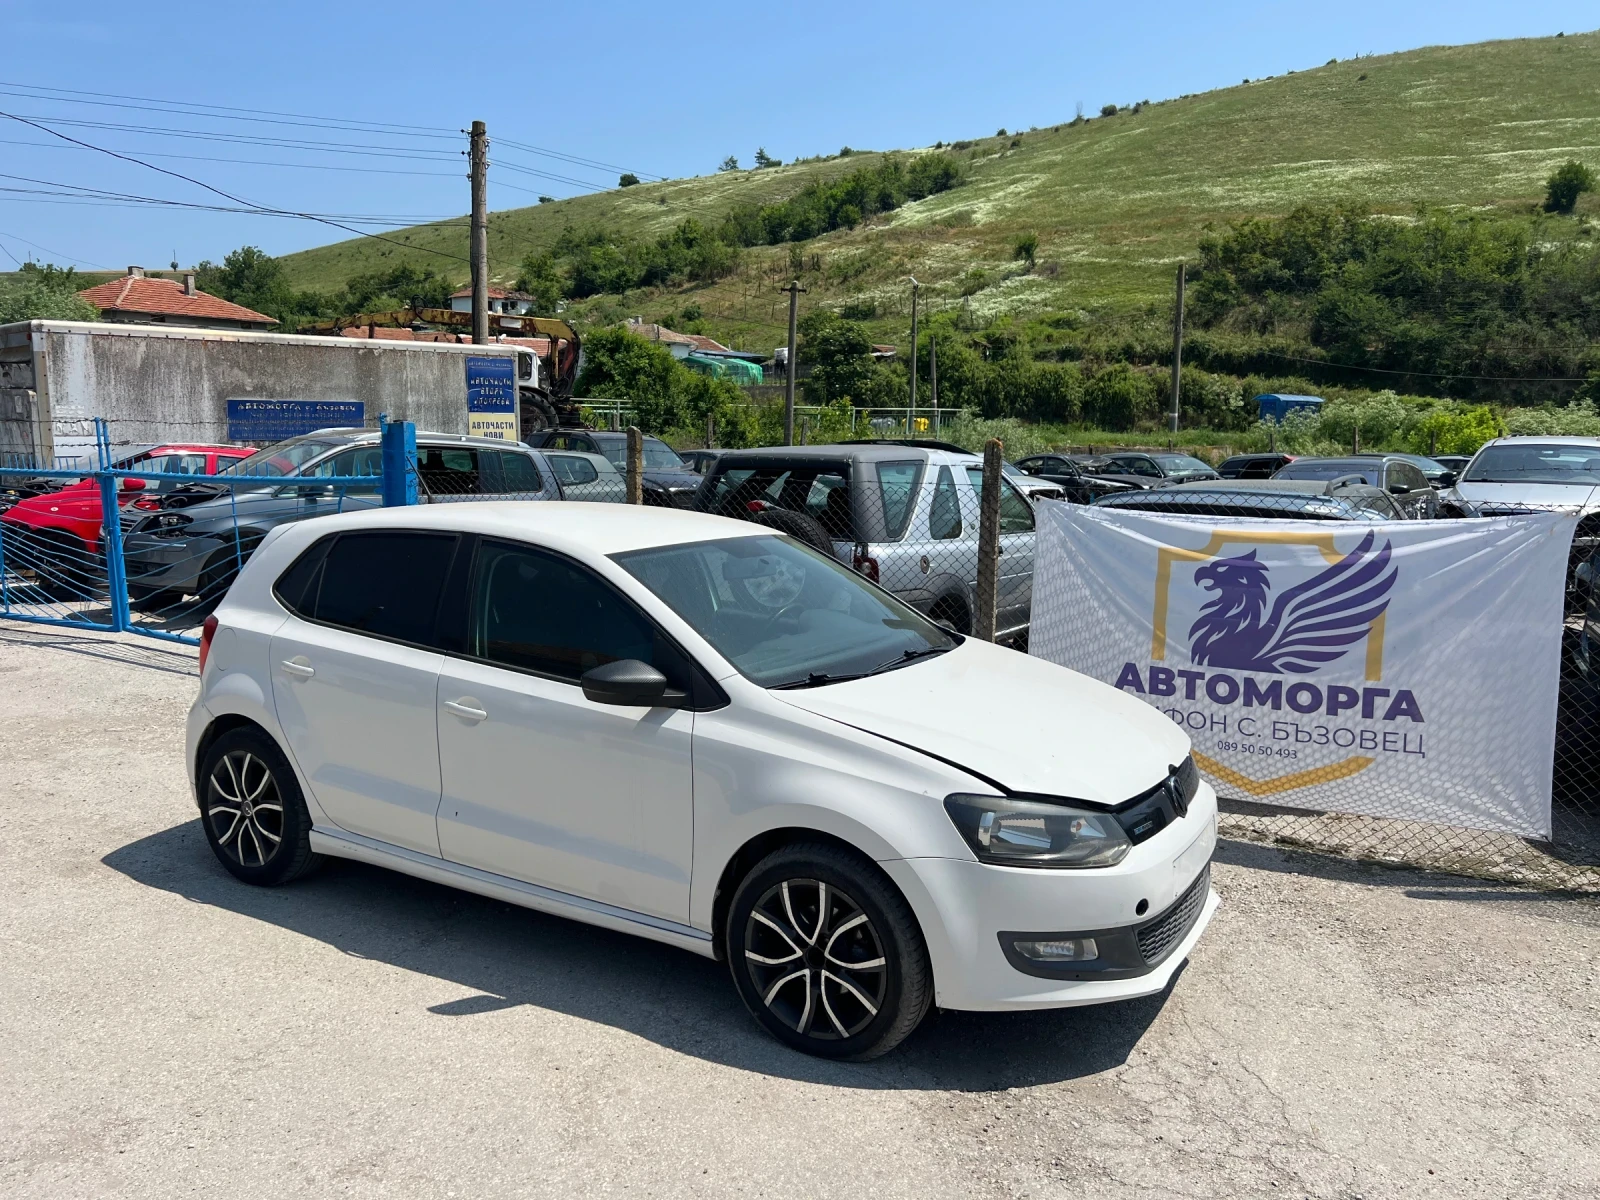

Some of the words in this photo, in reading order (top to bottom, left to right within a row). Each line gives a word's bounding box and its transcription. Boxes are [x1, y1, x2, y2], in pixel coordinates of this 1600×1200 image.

[471, 421, 514, 430] АВТОЧАСТИ
[483, 431, 504, 440] НОВИ
[1113, 662, 1425, 723] АВТОМОРГА
[1237, 717, 1261, 738] С.
[1272, 721, 1426, 759] БЪЗОВЕЦ
[1217, 740, 1238, 752] 089
[1241, 743, 1255, 754] 50
[1258, 746, 1272, 756] 50
[1275, 748, 1298, 760] 493
